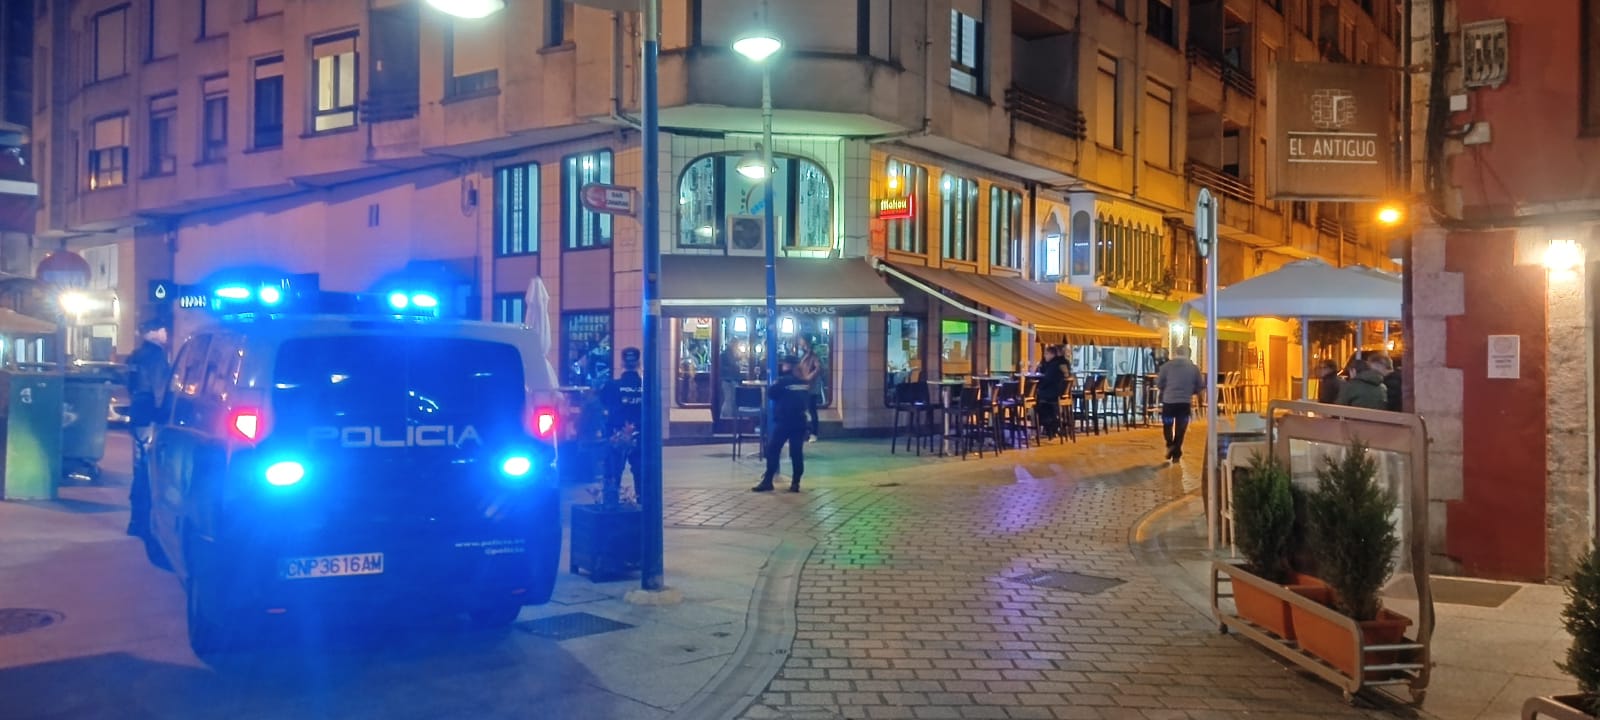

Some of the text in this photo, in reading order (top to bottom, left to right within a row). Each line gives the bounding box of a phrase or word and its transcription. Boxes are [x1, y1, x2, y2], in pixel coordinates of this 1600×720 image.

[1289, 138, 1376, 157] EL ANTIGUO
[880, 199, 907, 211] Mahou
[781, 306, 837, 315] CANARIAS
[306, 425, 483, 449] POLICIA
[287, 554, 382, 577] CNP3616AM
